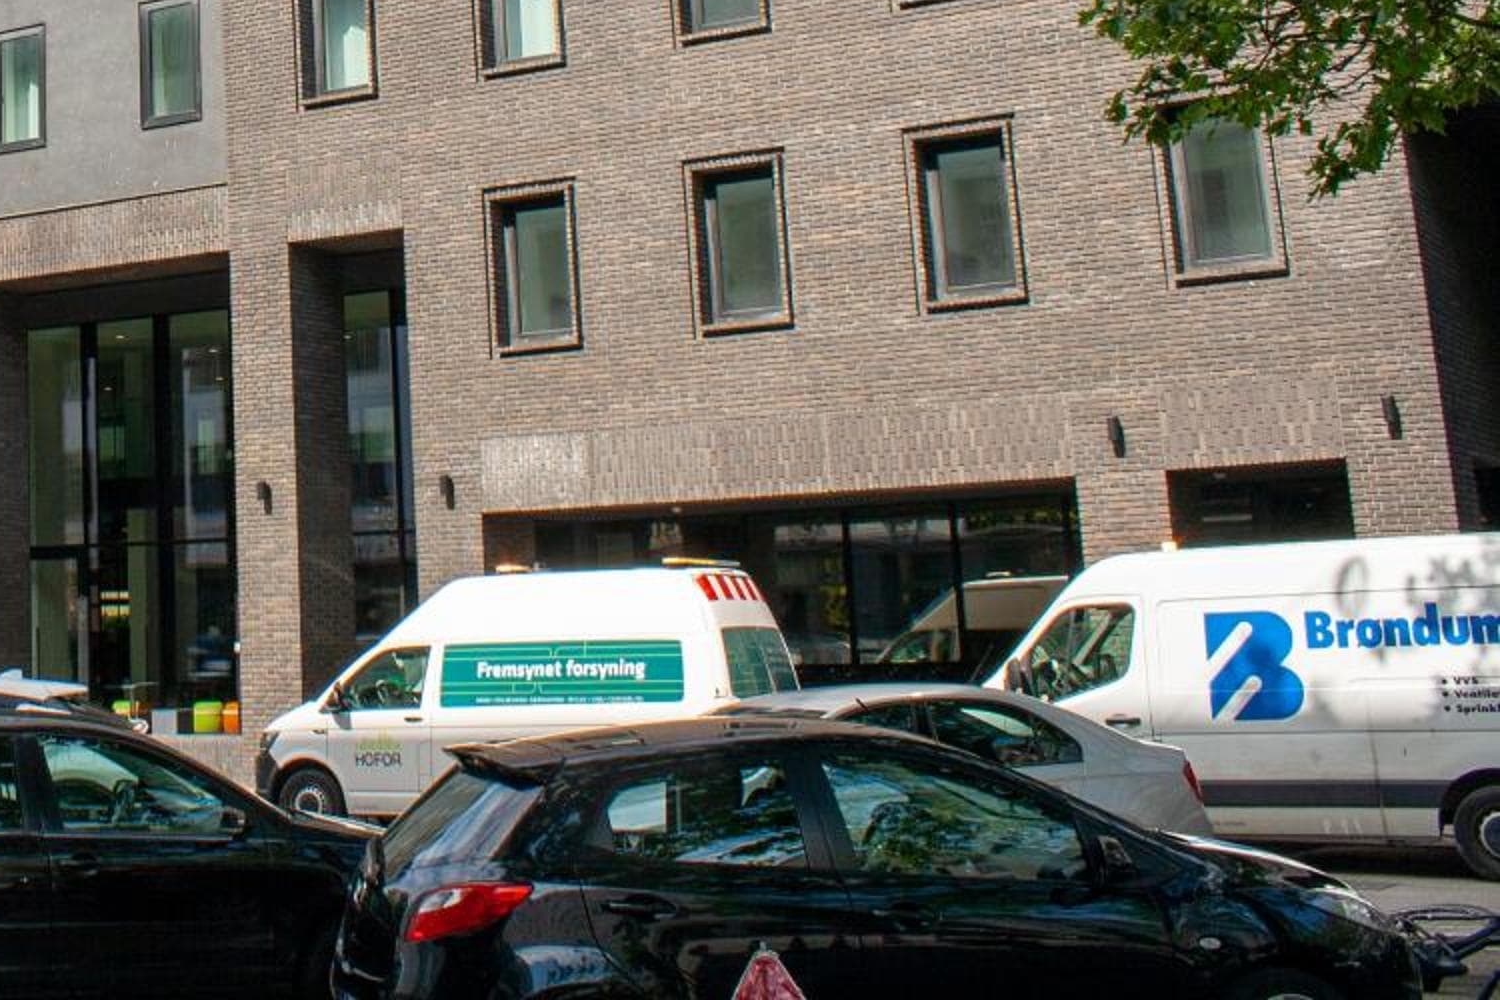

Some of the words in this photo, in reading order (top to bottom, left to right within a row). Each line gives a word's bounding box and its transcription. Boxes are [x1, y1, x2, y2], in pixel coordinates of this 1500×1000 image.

[1304, 602, 1500, 649] Brøndum
[476, 659, 561, 681] Fremsynet
[565, 657, 646, 680] forsyning
